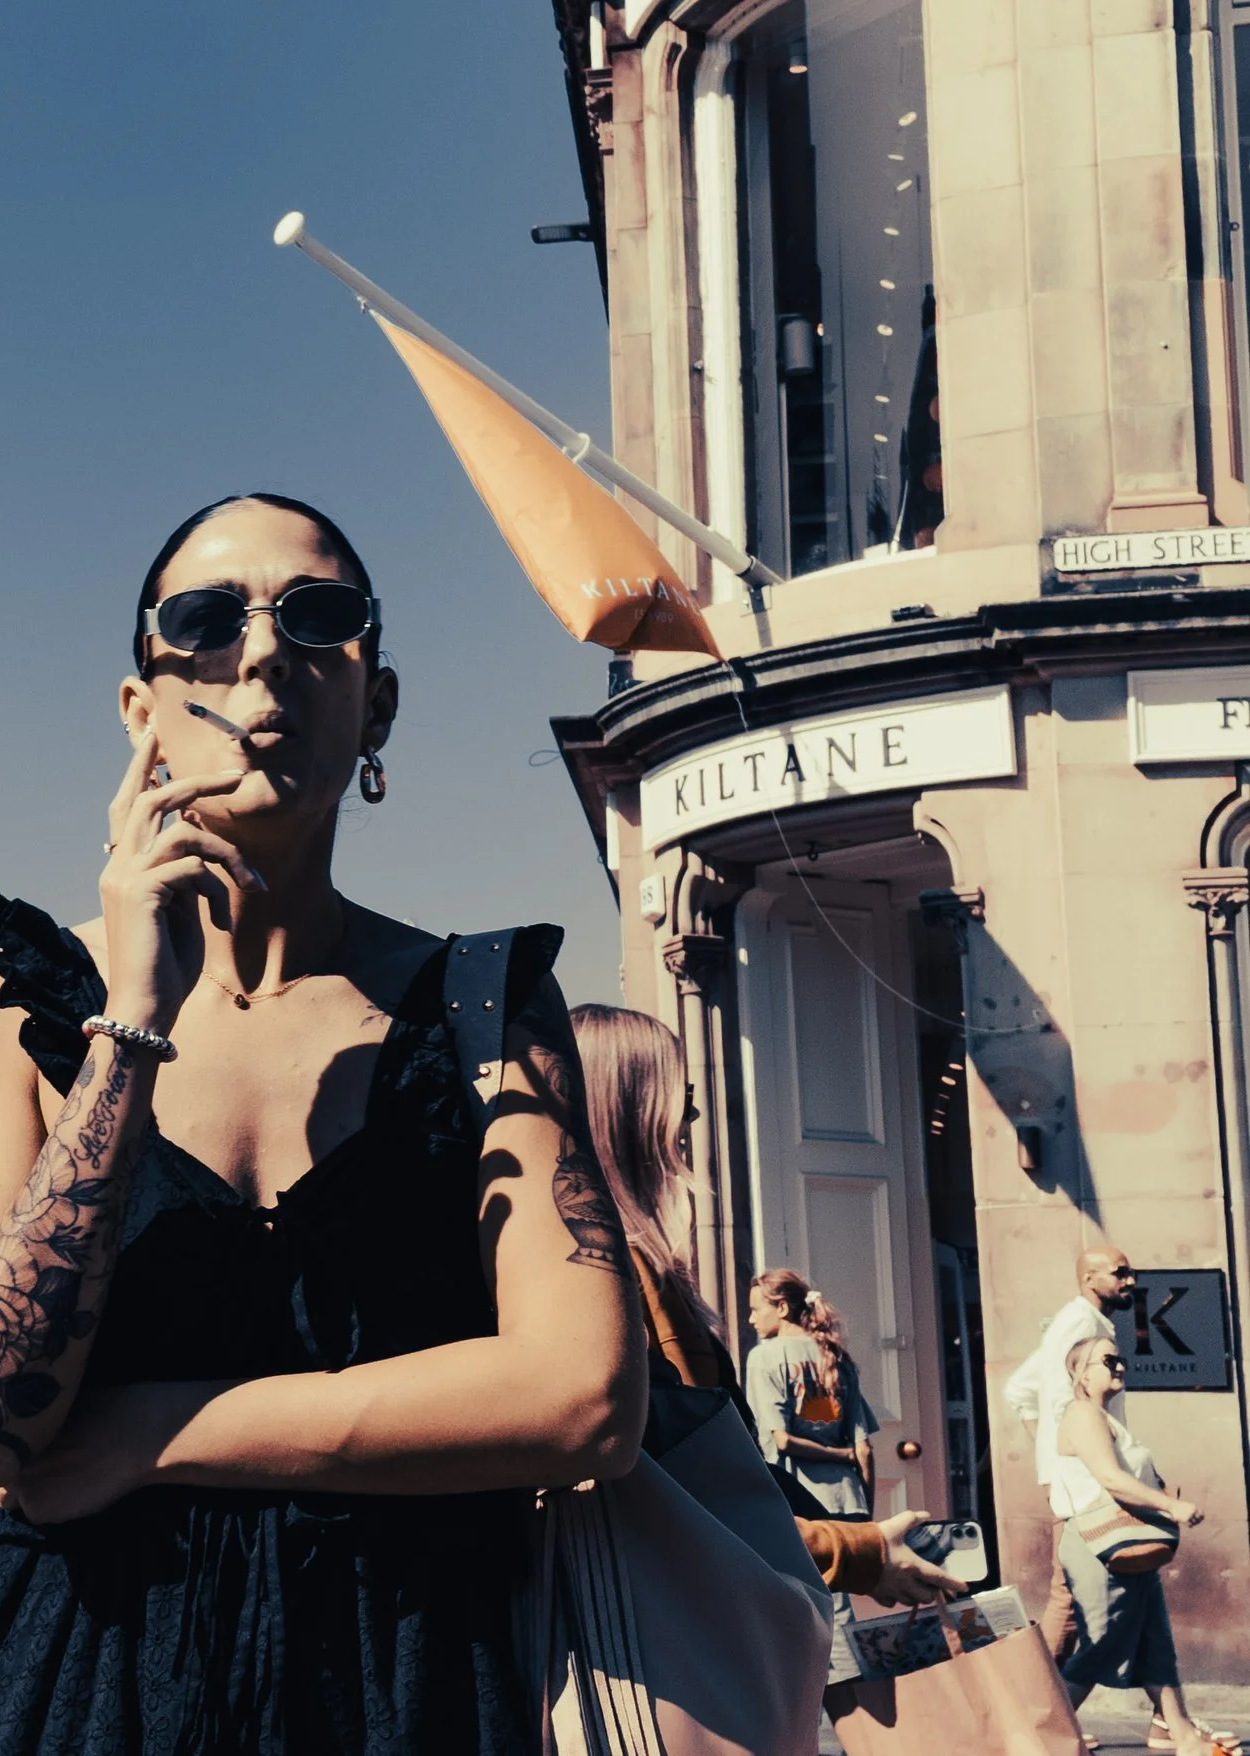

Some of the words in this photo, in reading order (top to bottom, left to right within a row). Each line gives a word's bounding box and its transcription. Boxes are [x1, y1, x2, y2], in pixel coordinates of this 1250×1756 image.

[1061, 539, 1132, 566] HIGH
[1153, 531, 1250, 560] STREE
[1215, 696, 1250, 729] F
[674, 724, 909, 816] KILTANE
[1132, 1287, 1196, 1356] K
[1134, 1362, 1197, 1373] KILTANE
